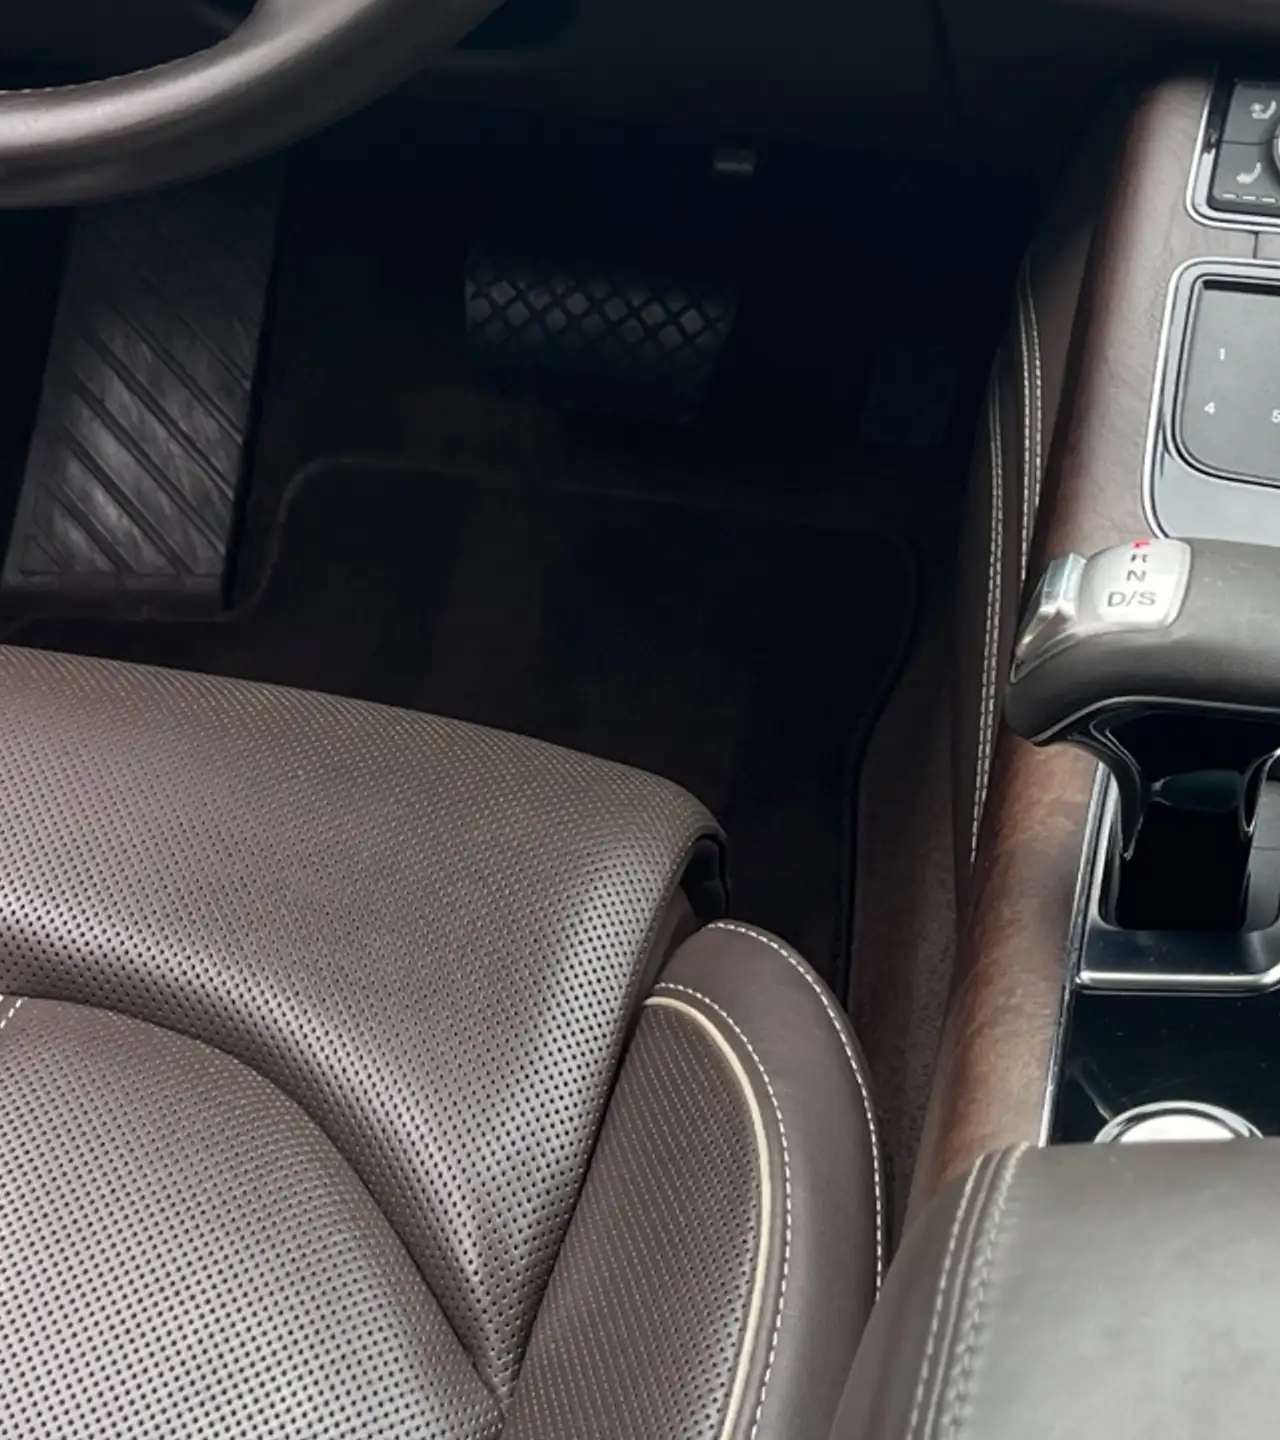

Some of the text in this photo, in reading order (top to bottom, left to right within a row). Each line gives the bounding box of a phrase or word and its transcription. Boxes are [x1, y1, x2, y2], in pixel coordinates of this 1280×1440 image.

[1218, 348, 1226, 361] 1
[1204, 401, 1216, 414] 4
[1126, 569, 1147, 582] N
[1107, 590, 1157, 608] D/S
